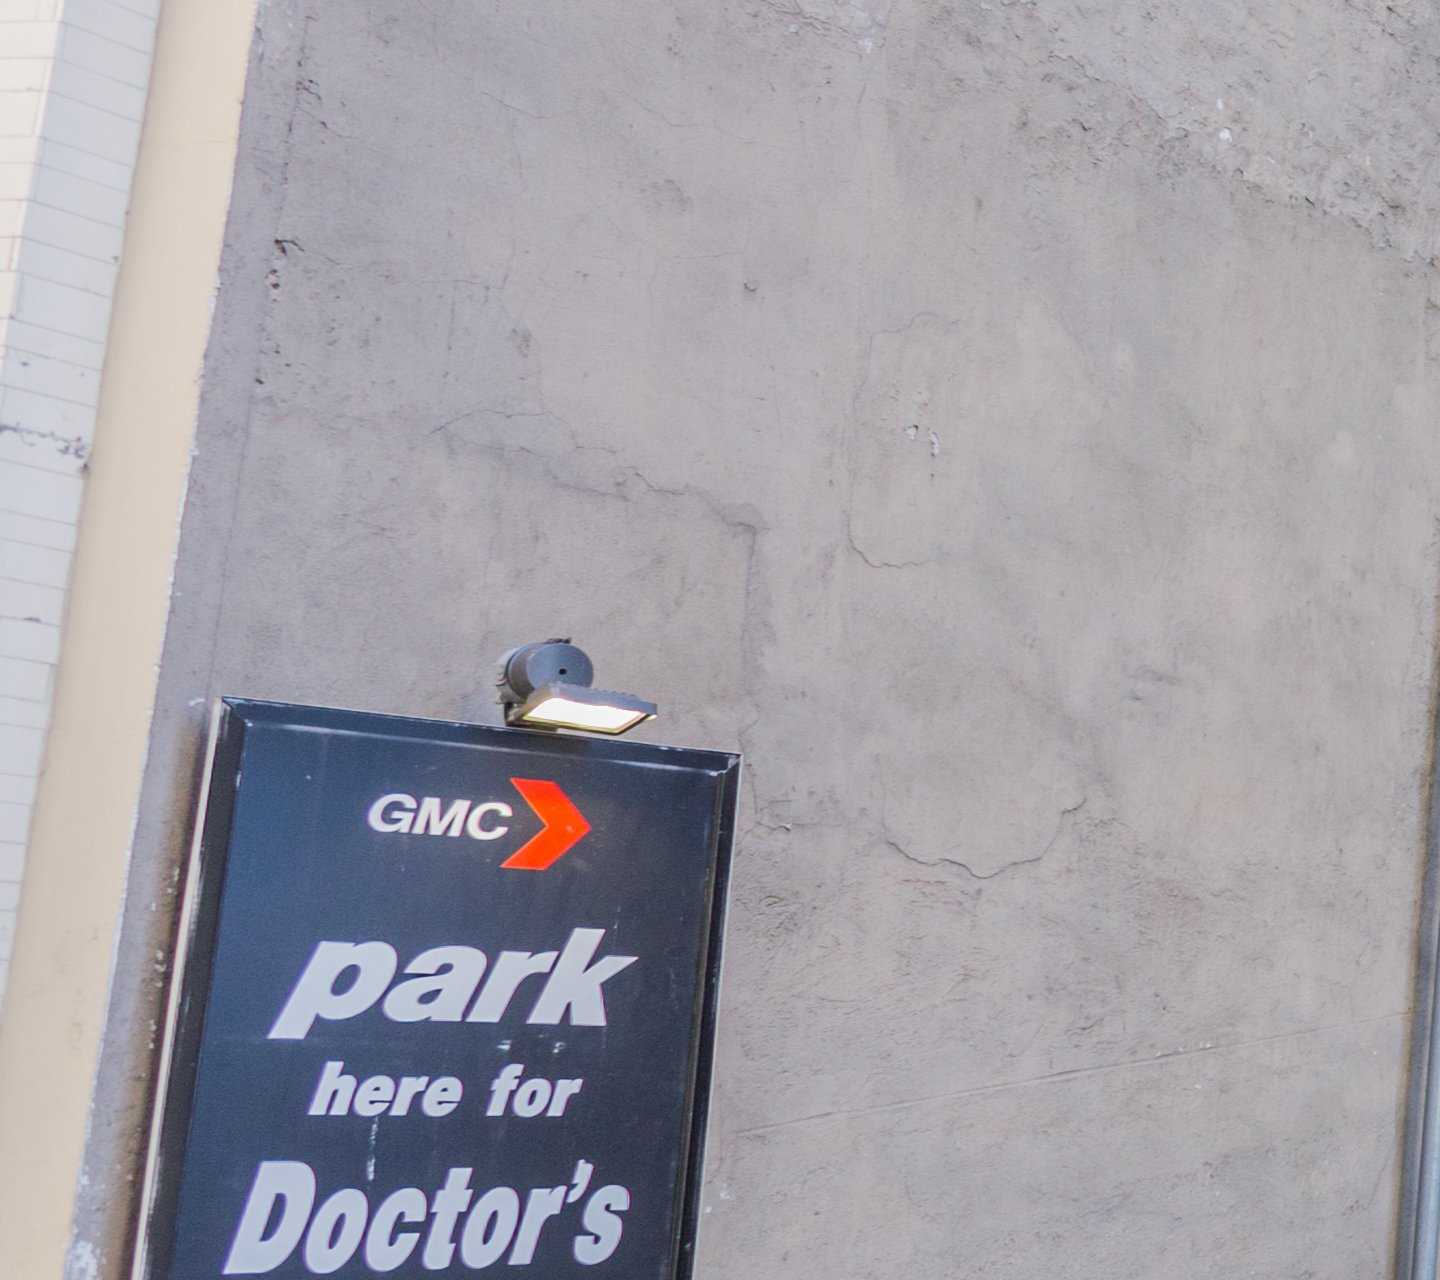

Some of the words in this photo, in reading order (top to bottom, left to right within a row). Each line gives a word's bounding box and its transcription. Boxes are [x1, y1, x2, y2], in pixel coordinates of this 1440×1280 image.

[367, 793, 512, 841] GMC
[267, 928, 639, 1040] park
[309, 1061, 461, 1117] here
[486, 1063, 584, 1117] for
[222, 1159, 630, 1276] Doctor's
